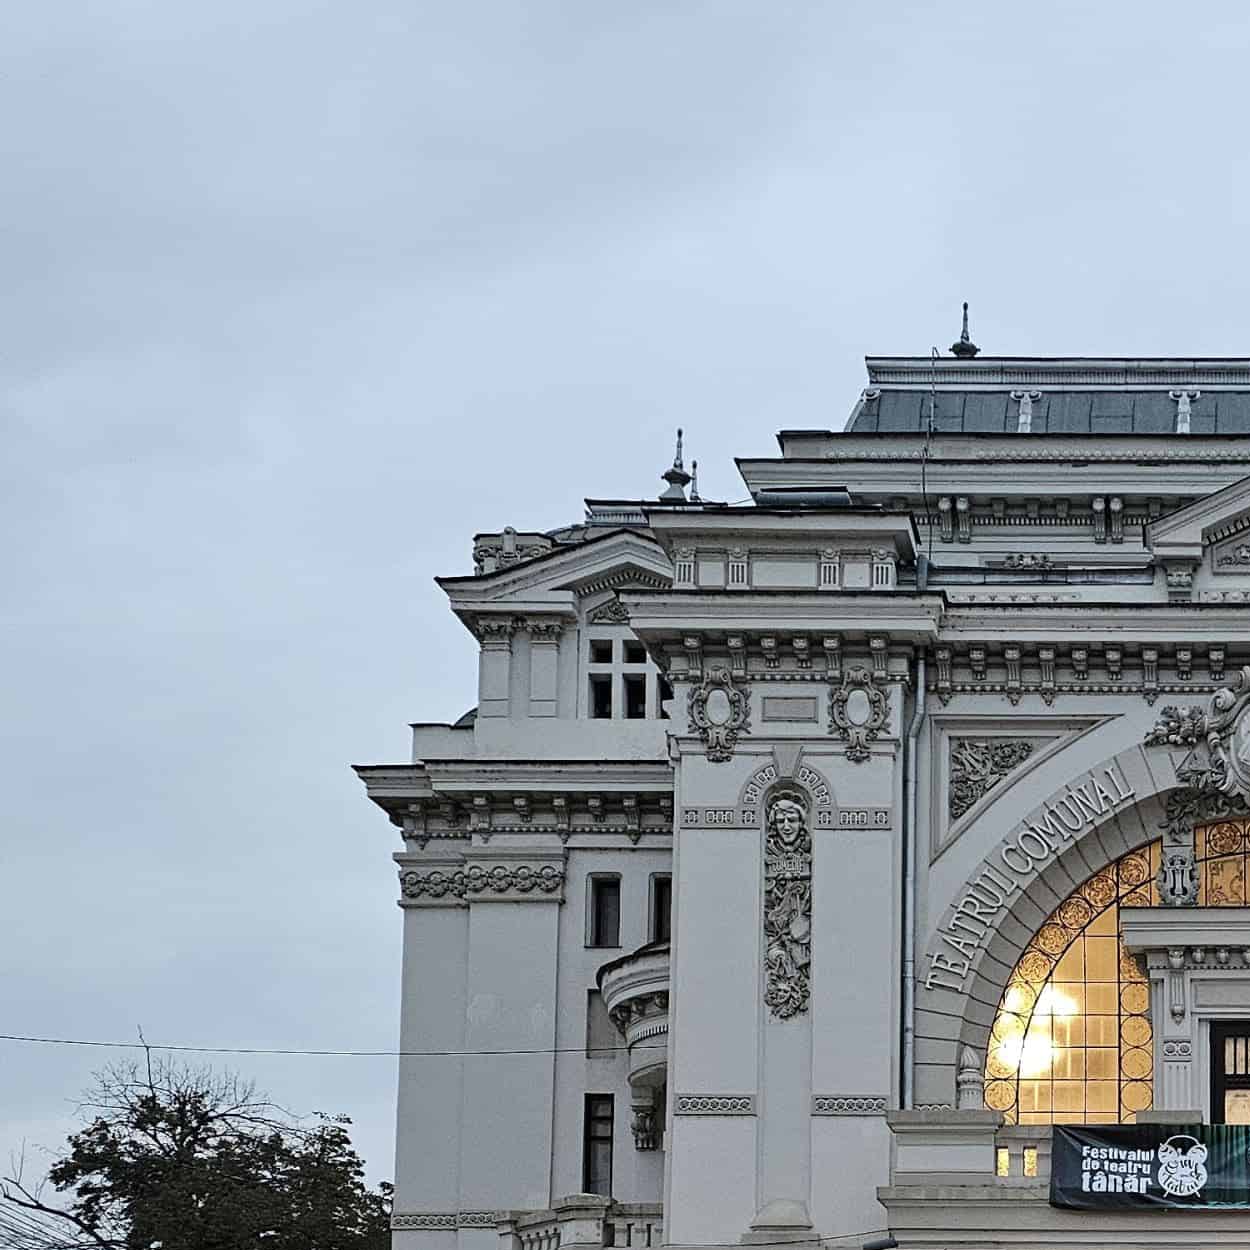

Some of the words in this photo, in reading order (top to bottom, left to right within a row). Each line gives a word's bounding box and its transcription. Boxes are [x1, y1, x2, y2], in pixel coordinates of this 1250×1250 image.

[925, 868, 1018, 992] TEATRUL
[1002, 767, 1136, 875] COMUNAL
[1082, 1146, 1154, 1161] Festivalul
[1082, 1158, 1099, 1171] de
[1103, 1161, 1151, 1174] teatru
[1081, 1172, 1152, 1194] tânăr
